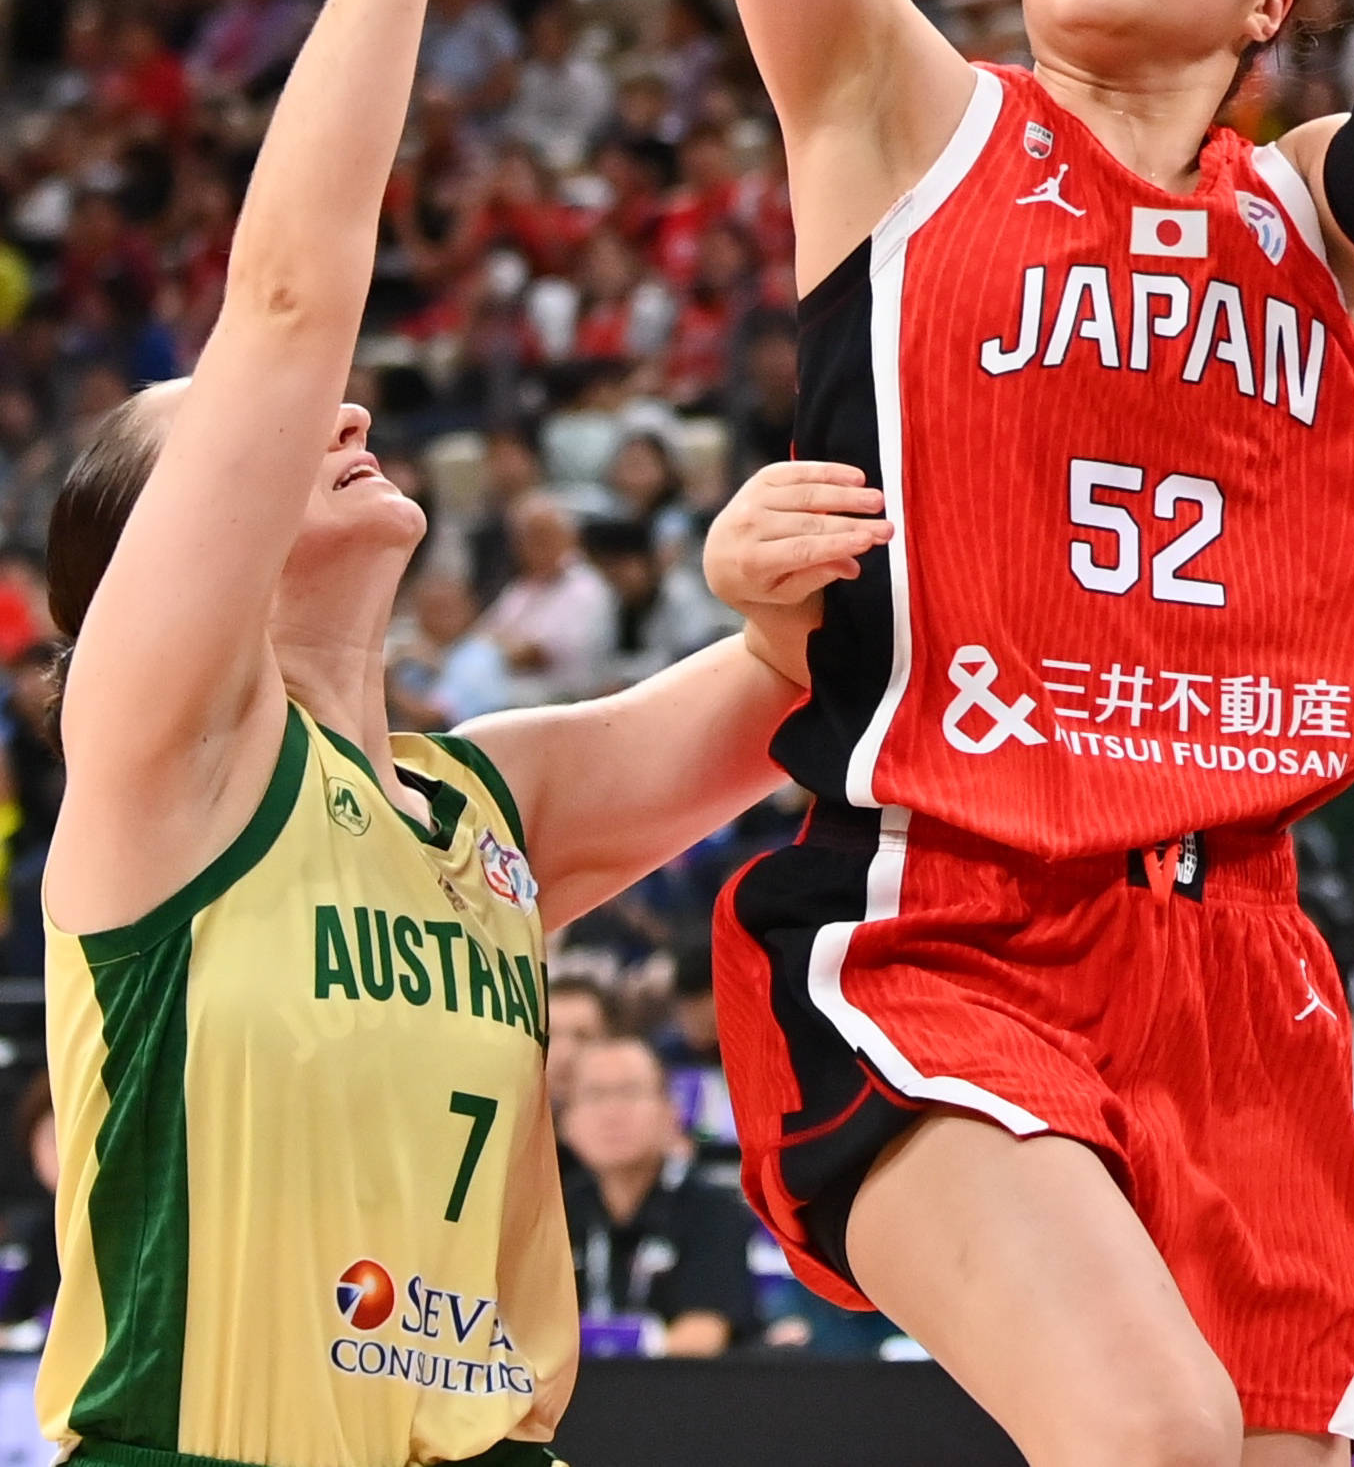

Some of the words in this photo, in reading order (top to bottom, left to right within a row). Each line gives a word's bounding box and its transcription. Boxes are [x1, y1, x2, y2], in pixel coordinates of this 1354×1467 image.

[980, 264, 1327, 427] JAPAN
[1068, 457, 1226, 607] 52
[942, 644, 1048, 754] &
[1041, 658, 1352, 739] 三井不動産
[1171, 741, 1349, 780] FUDOSAN
[444, 1090, 498, 1223] 7
